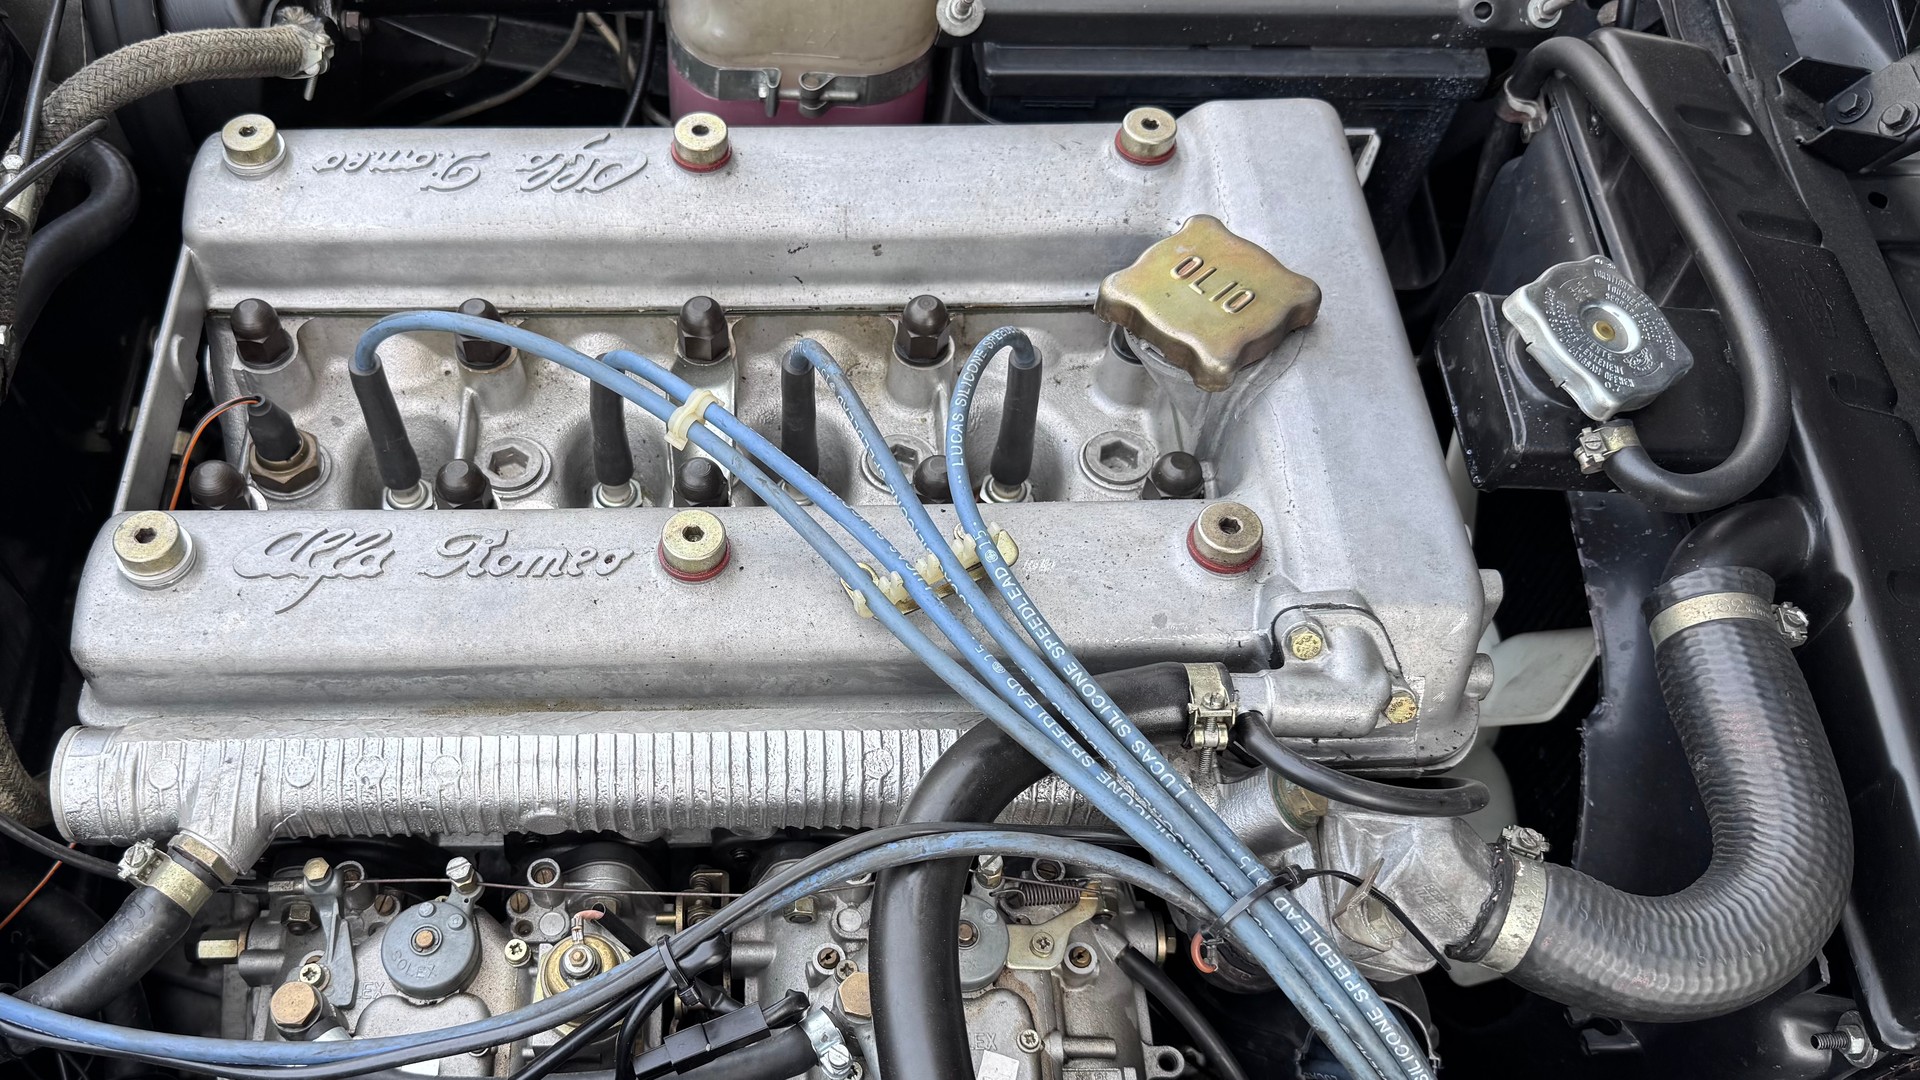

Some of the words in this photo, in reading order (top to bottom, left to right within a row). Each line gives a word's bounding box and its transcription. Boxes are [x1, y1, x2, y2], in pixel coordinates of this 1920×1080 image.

[312, 150, 490, 192] Romeo
[515, 133, 648, 194] Alfa
[1169, 255, 1256, 314] OLIO
[955, 351, 987, 407] SILICONE
[950, 413, 965, 467] LUCAS
[232, 527, 396, 615] Alfa
[418, 527, 634, 580] Romeo
[994, 566, 1066, 659] SPEEDLEAD
[1006, 677, 1095, 768] SPEEDLEAD
[1063, 661, 1132, 738] SILICONE
[1130, 740, 1188, 799] LUCAS
[392, 950, 437, 979] SOLEX
[1273, 896, 1369, 1003] SPEEDLEAD
